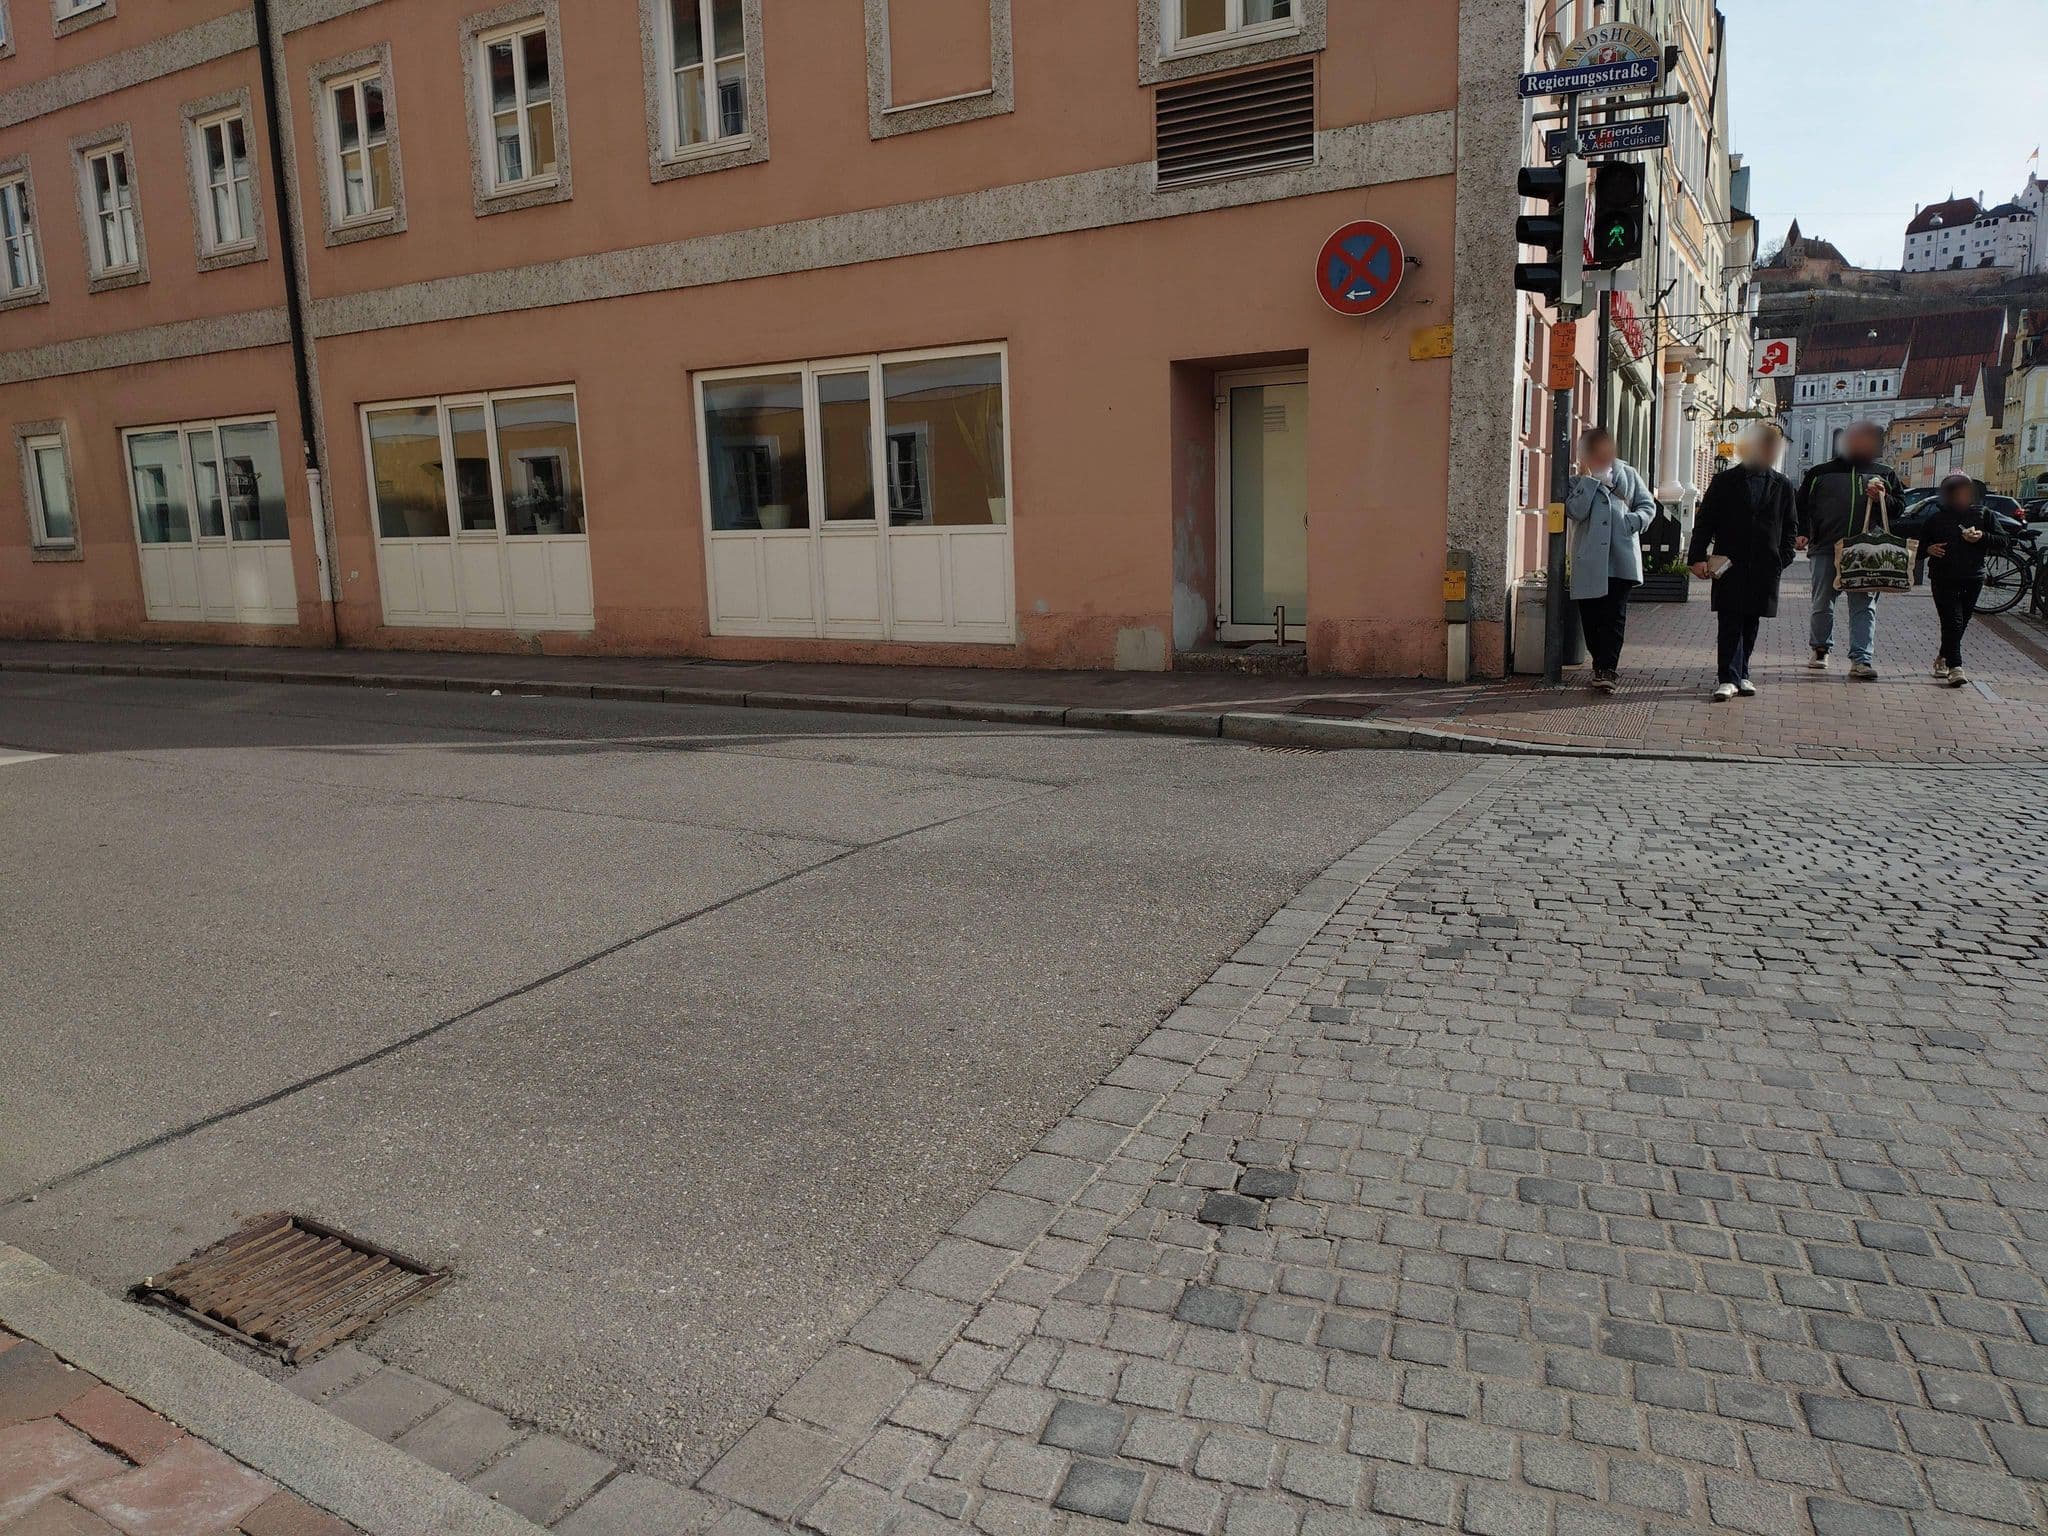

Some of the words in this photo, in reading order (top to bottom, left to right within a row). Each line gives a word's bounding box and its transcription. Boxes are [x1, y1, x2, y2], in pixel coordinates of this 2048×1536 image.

[1565, 27, 1653, 66] ANDSHUTE
[1526, 62, 1648, 93] Regierungsstraße
[1588, 131, 1597, 140] &
[1600, 125, 1643, 139] Friends
[1591, 140, 1619, 151] Asian
[1622, 134, 1661, 146] Cuisine
